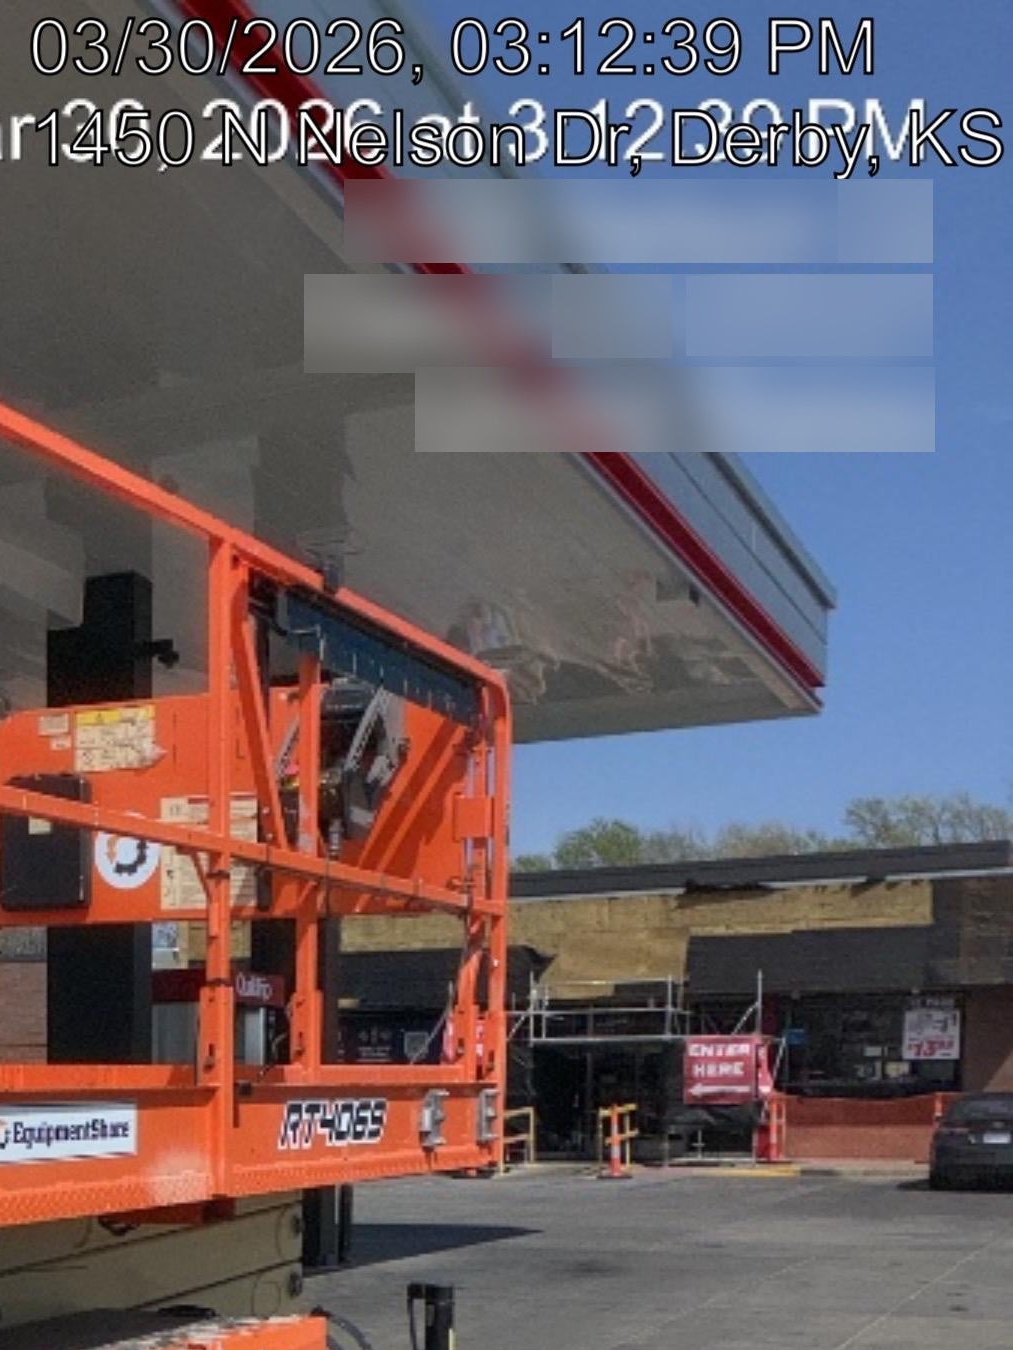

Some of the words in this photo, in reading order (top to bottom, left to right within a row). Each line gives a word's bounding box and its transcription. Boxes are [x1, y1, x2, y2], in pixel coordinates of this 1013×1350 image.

[688, 1043, 751, 1057] ENTER
[693, 1062, 744, 1078] HERE
[12, 1118, 130, 1150] EquipmentShare
